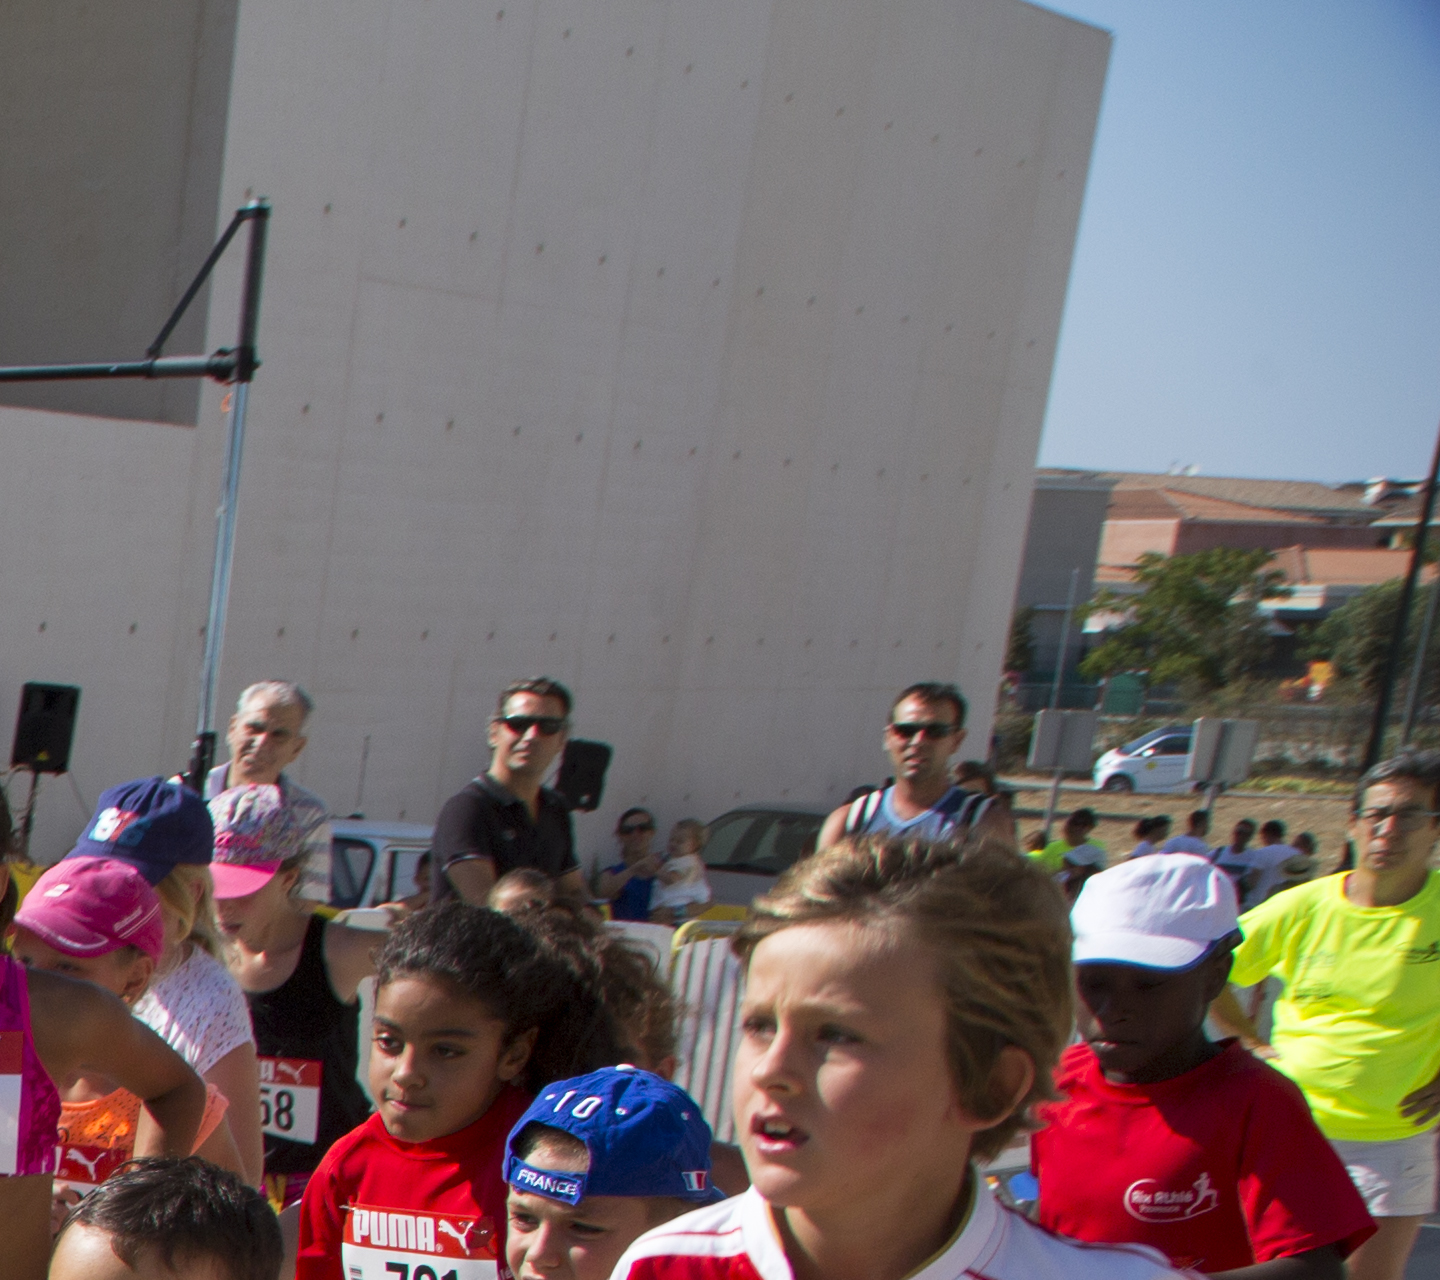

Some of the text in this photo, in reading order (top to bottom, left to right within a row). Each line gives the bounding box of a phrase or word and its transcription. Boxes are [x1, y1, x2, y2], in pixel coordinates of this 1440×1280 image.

[553, 1090, 602, 1119] 10
[517, 1168, 579, 1195] FRANCE
[352, 1209, 436, 1252] PUMA
